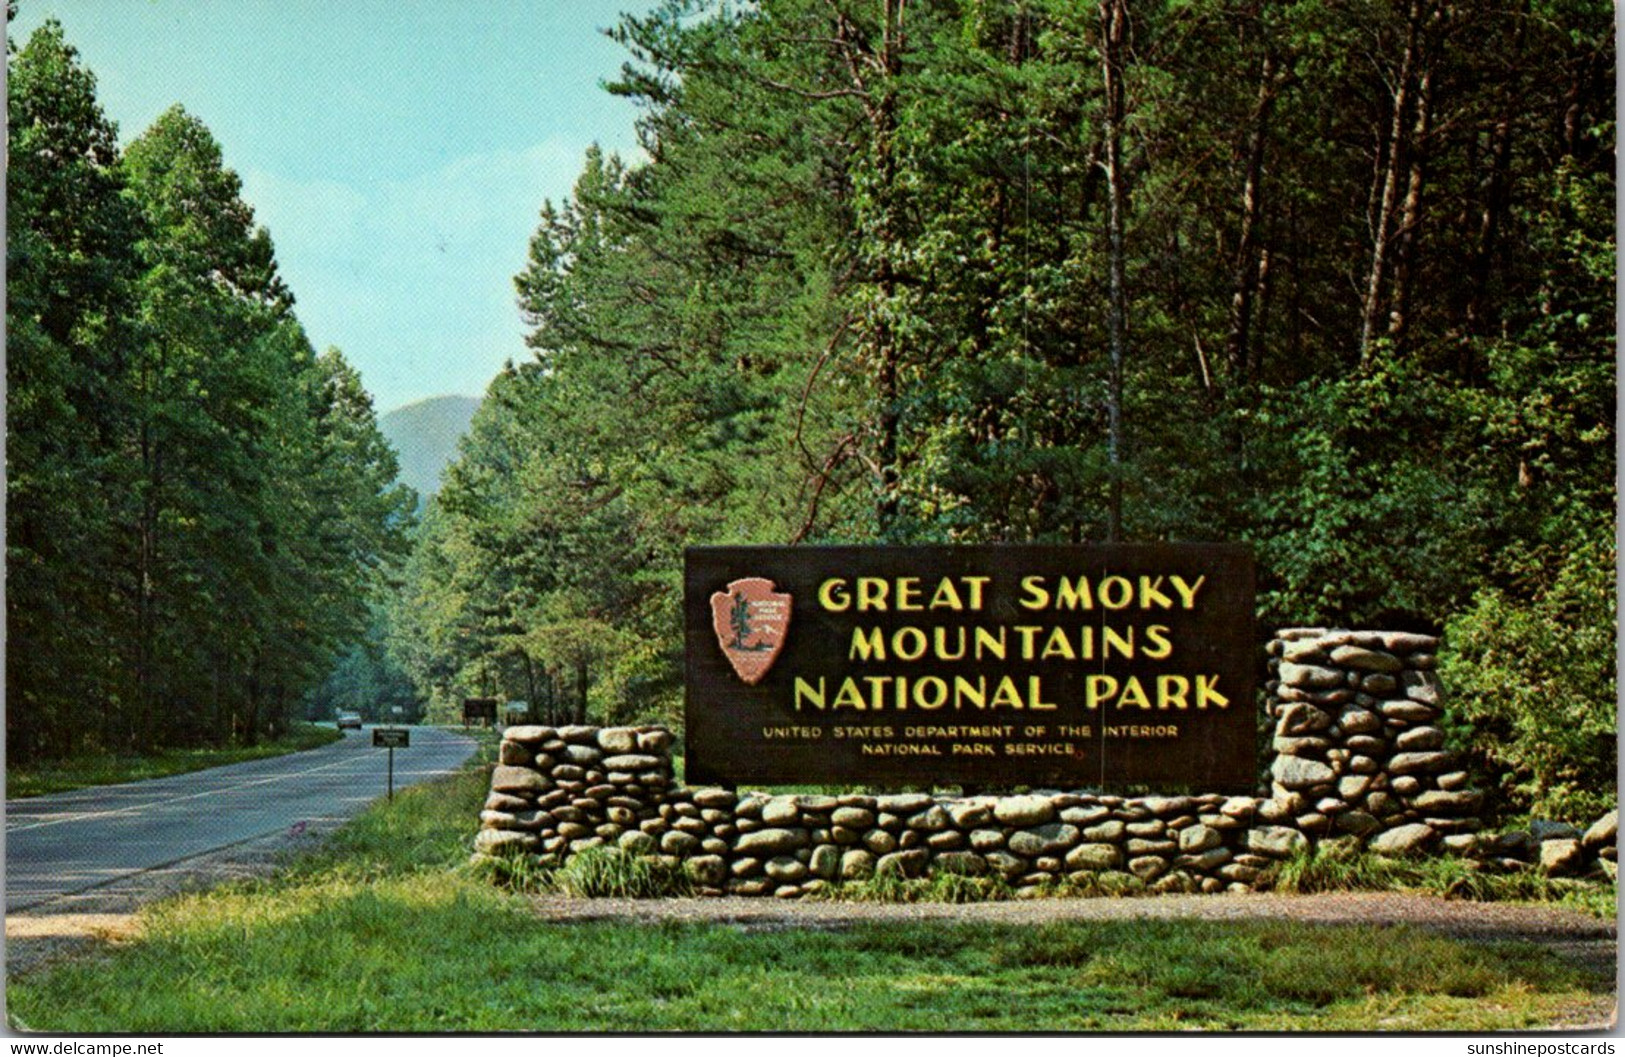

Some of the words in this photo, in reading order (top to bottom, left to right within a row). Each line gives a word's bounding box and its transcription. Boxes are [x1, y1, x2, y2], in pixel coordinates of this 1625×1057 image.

[818, 576, 991, 611] GREAT
[1018, 575, 1206, 611] SMOKY
[848, 624, 1173, 661] MOUNTAINS
[793, 675, 1057, 710] NATIONAL
[1085, 674, 1230, 710] PARK
[762, 726, 822, 738] UNITED
[833, 726, 894, 738] STATES
[904, 725, 1013, 738] DEPARTMENT
[1024, 725, 1046, 737] OF
[1059, 725, 1092, 737] THE
[1102, 725, 1178, 737] INTERIOR
[862, 743, 942, 755] NATIONAL
[952, 743, 996, 755] PARK
[1004, 743, 1075, 755] SERVICE
